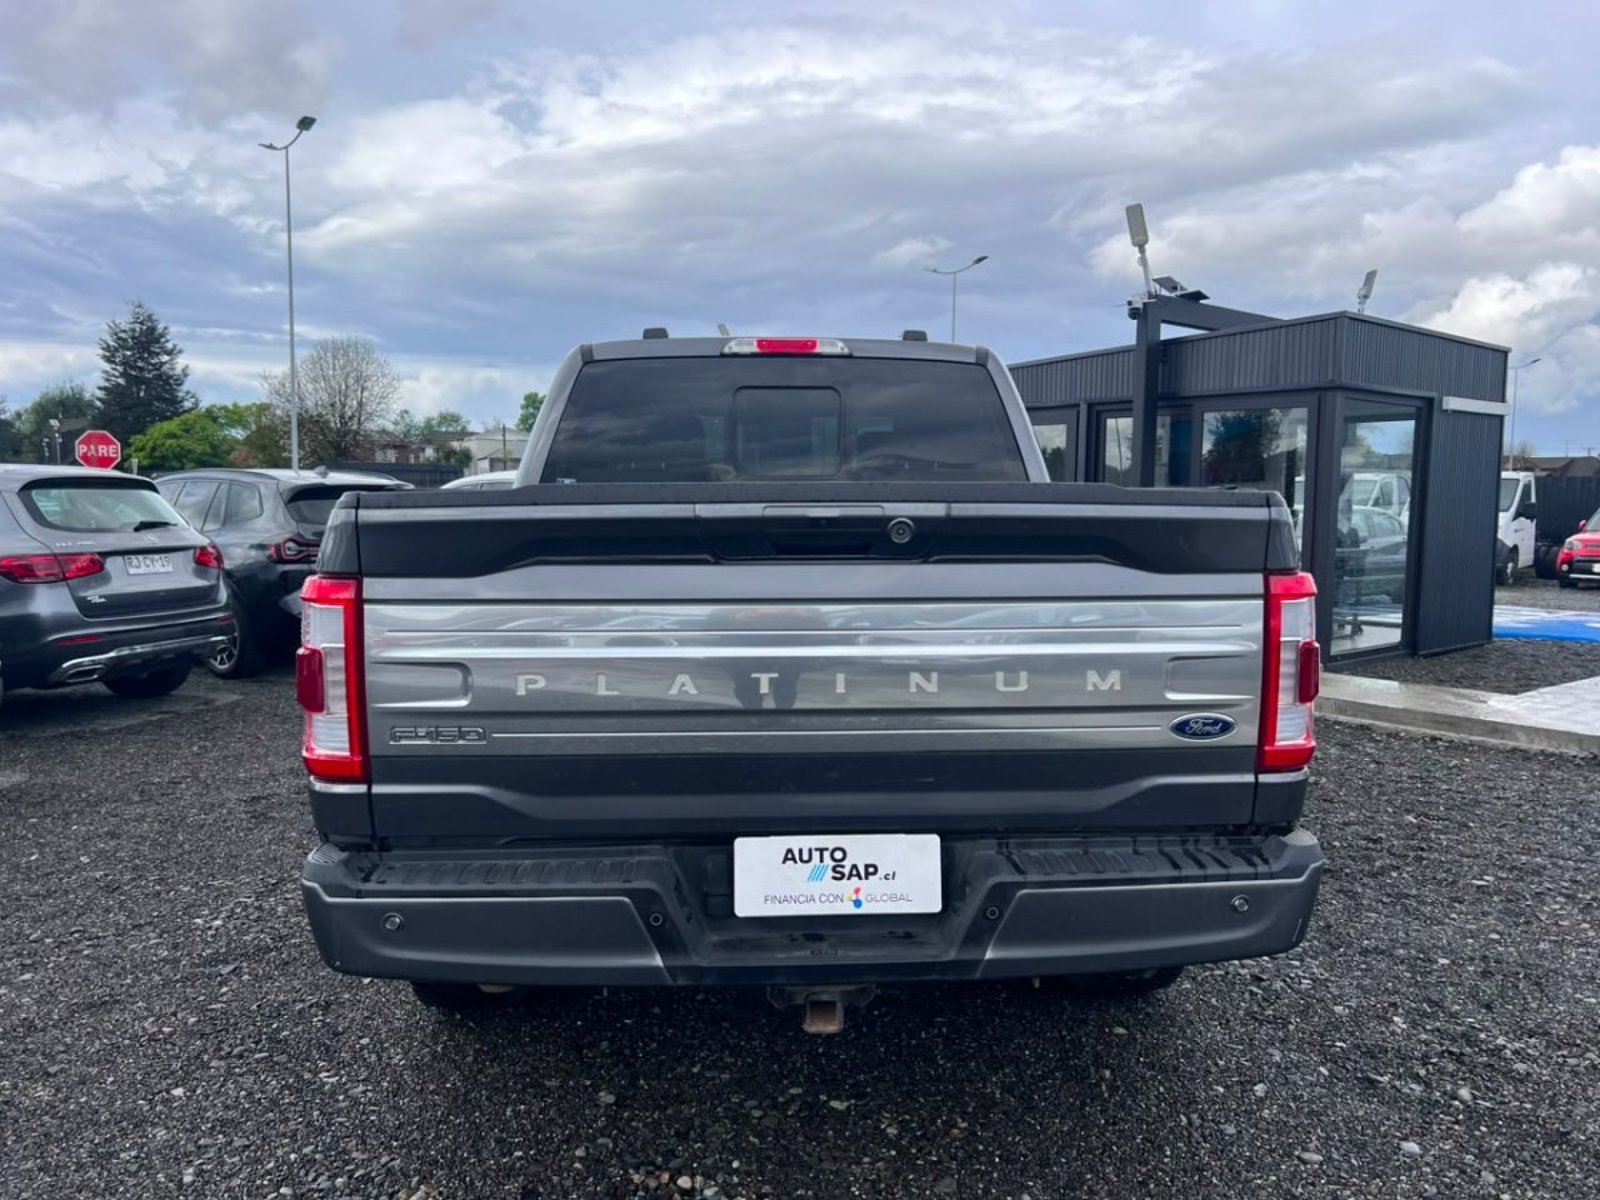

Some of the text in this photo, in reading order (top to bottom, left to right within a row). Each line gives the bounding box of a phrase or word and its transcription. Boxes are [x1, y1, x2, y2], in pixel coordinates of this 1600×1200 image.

[79, 444, 118, 458] PARE
[515, 669, 1122, 697] PLATINUM
[1184, 718, 1223, 735] Ford
[781, 846, 848, 865] AUTO
[764, 892, 913, 905] FINANCIA CON GLOBAL
